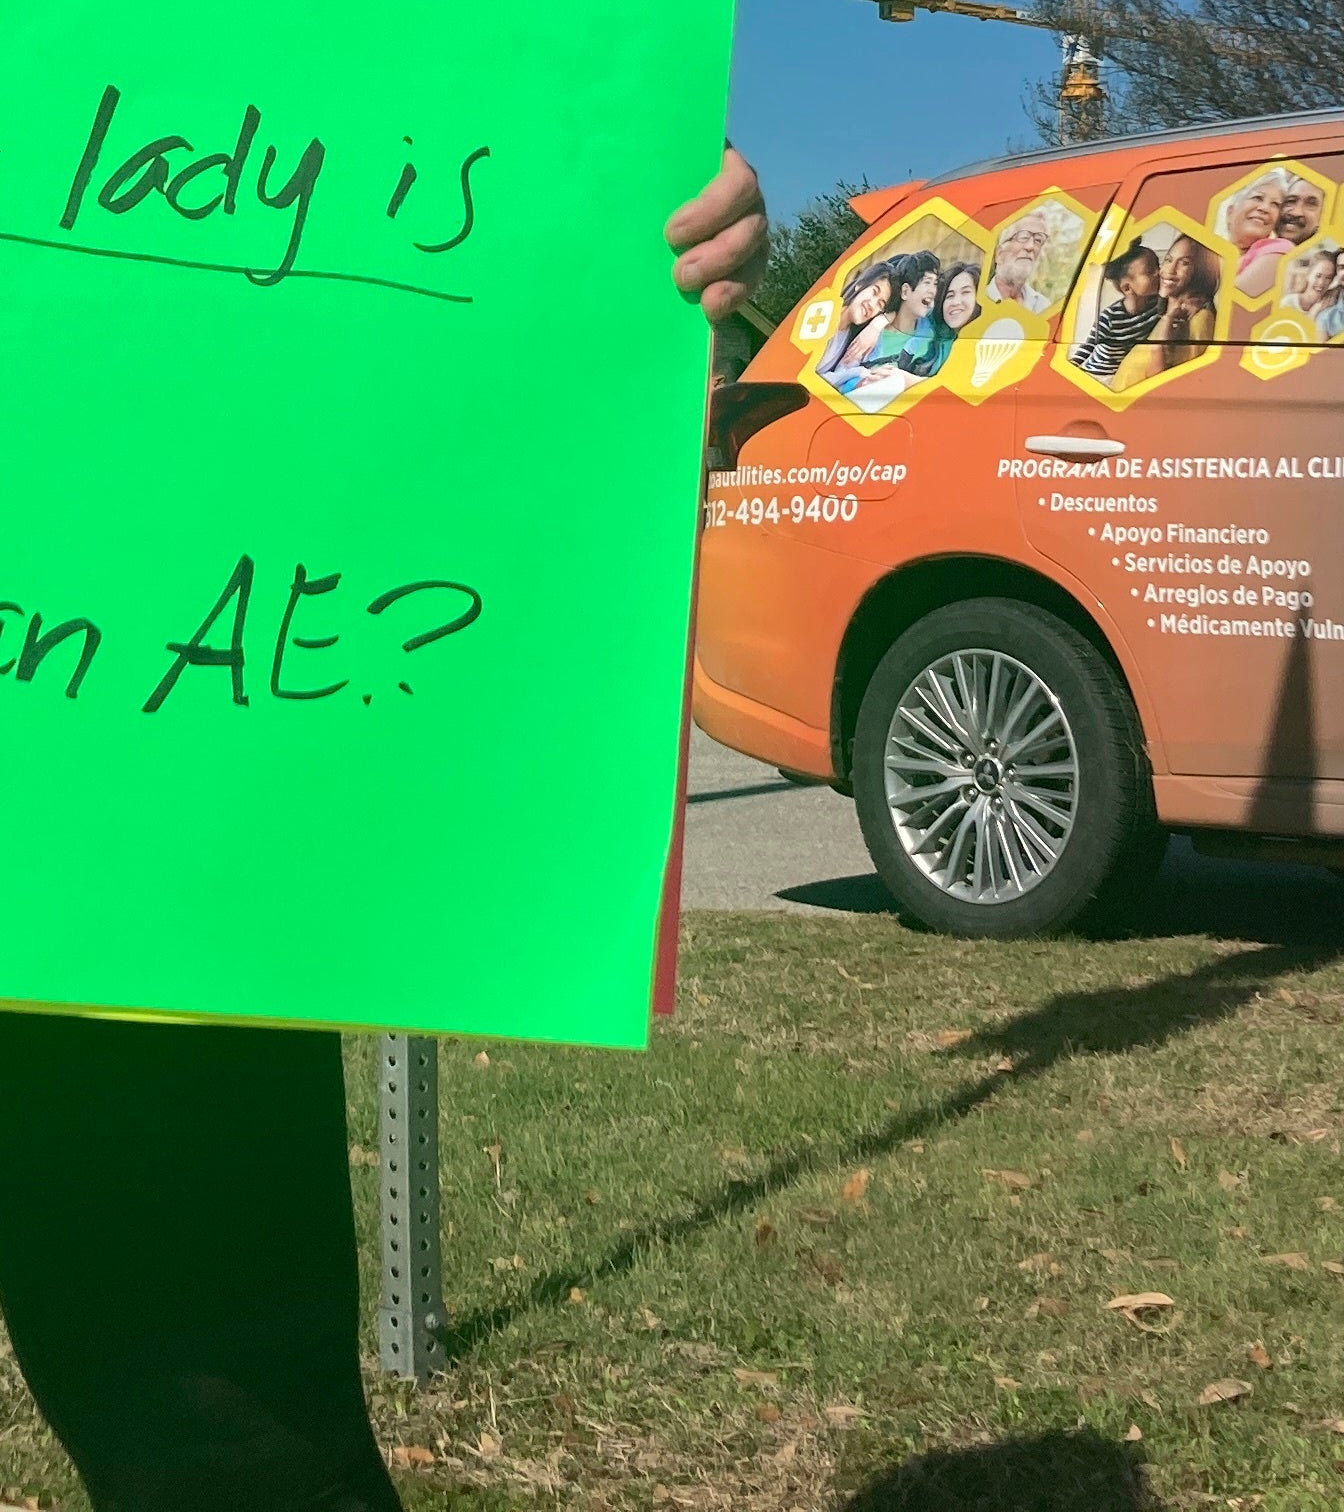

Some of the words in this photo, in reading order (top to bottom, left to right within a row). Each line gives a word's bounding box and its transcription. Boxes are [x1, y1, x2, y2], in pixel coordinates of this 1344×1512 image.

[60, 85, 325, 282] lady
[387, 147, 490, 252] is
[997, 457, 1111, 479] PROGRAMA
[1115, 457, 1143, 478] DE
[1146, 457, 1270, 479] ASISTENCIA
[1274, 457, 1304, 479] AL
[1050, 492, 1158, 513] Descuentos
[1100, 522, 1162, 546] Apoyo
[1166, 522, 1270, 545] Financiero
[1124, 552, 1213, 574] Servicios
[1216, 554, 1243, 575] de
[1245, 555, 1312, 580] Apoyo
[1143, 583, 1229, 608] Arreglos
[1232, 584, 1259, 606] de
[1261, 586, 1315, 611] Pago
[1160, 613, 1297, 638] Médicamente
